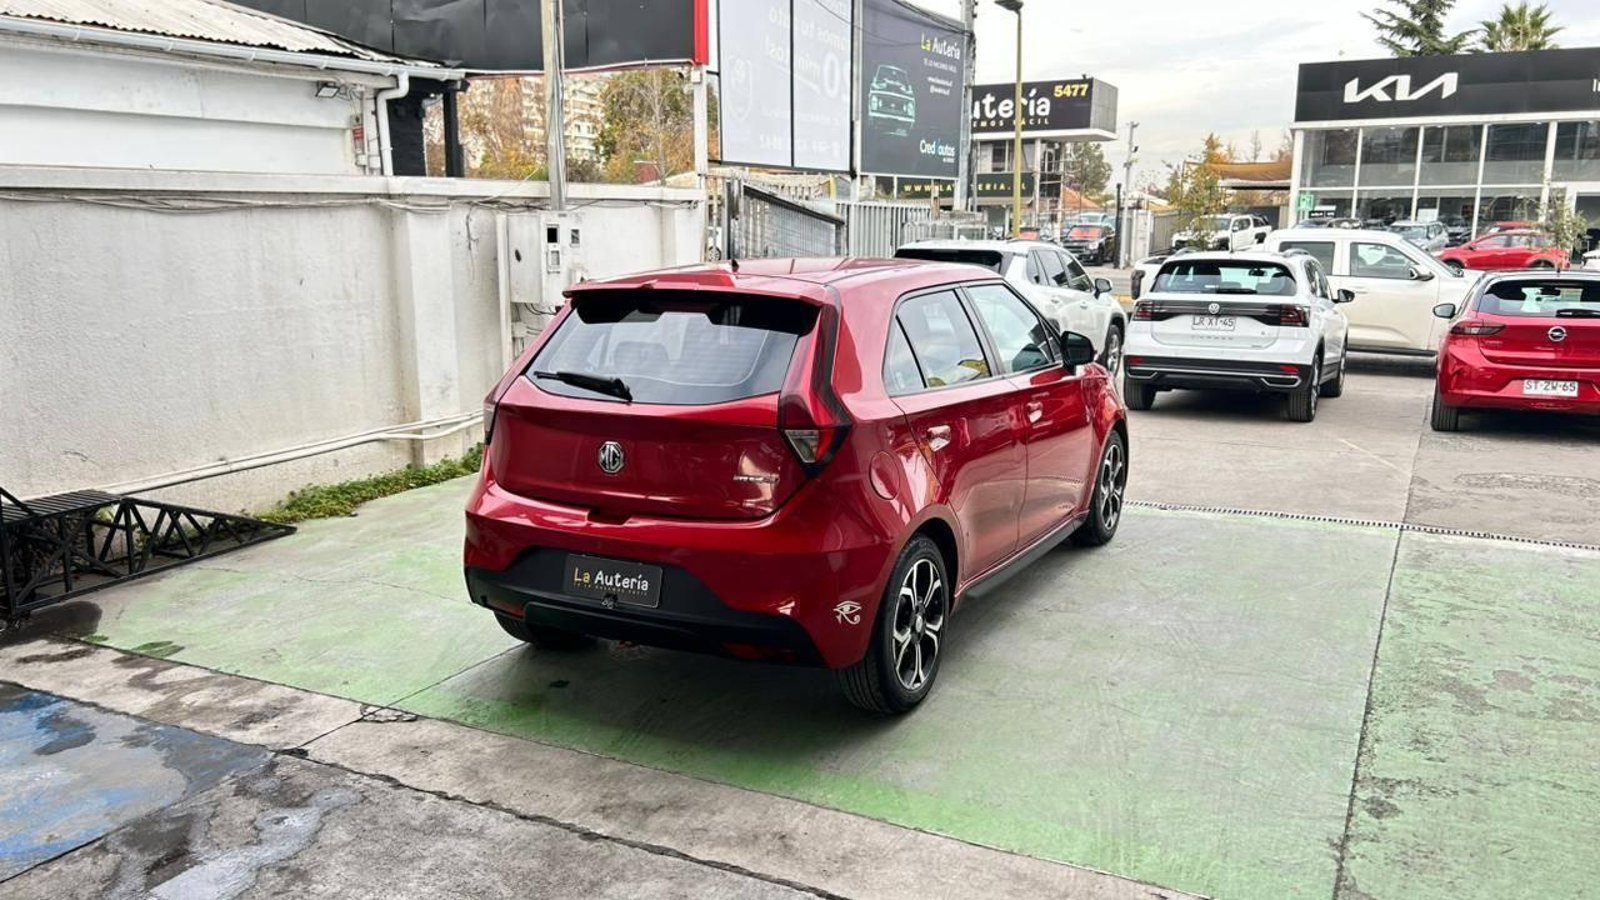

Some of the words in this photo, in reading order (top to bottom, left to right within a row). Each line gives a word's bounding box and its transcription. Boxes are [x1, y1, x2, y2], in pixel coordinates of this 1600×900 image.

[1053, 84, 1089, 98] 5477
[1343, 72, 1459, 103] KIA
[599, 442, 623, 472] MG
[574, 567, 591, 584] La
[594, 570, 649, 591] Autería
